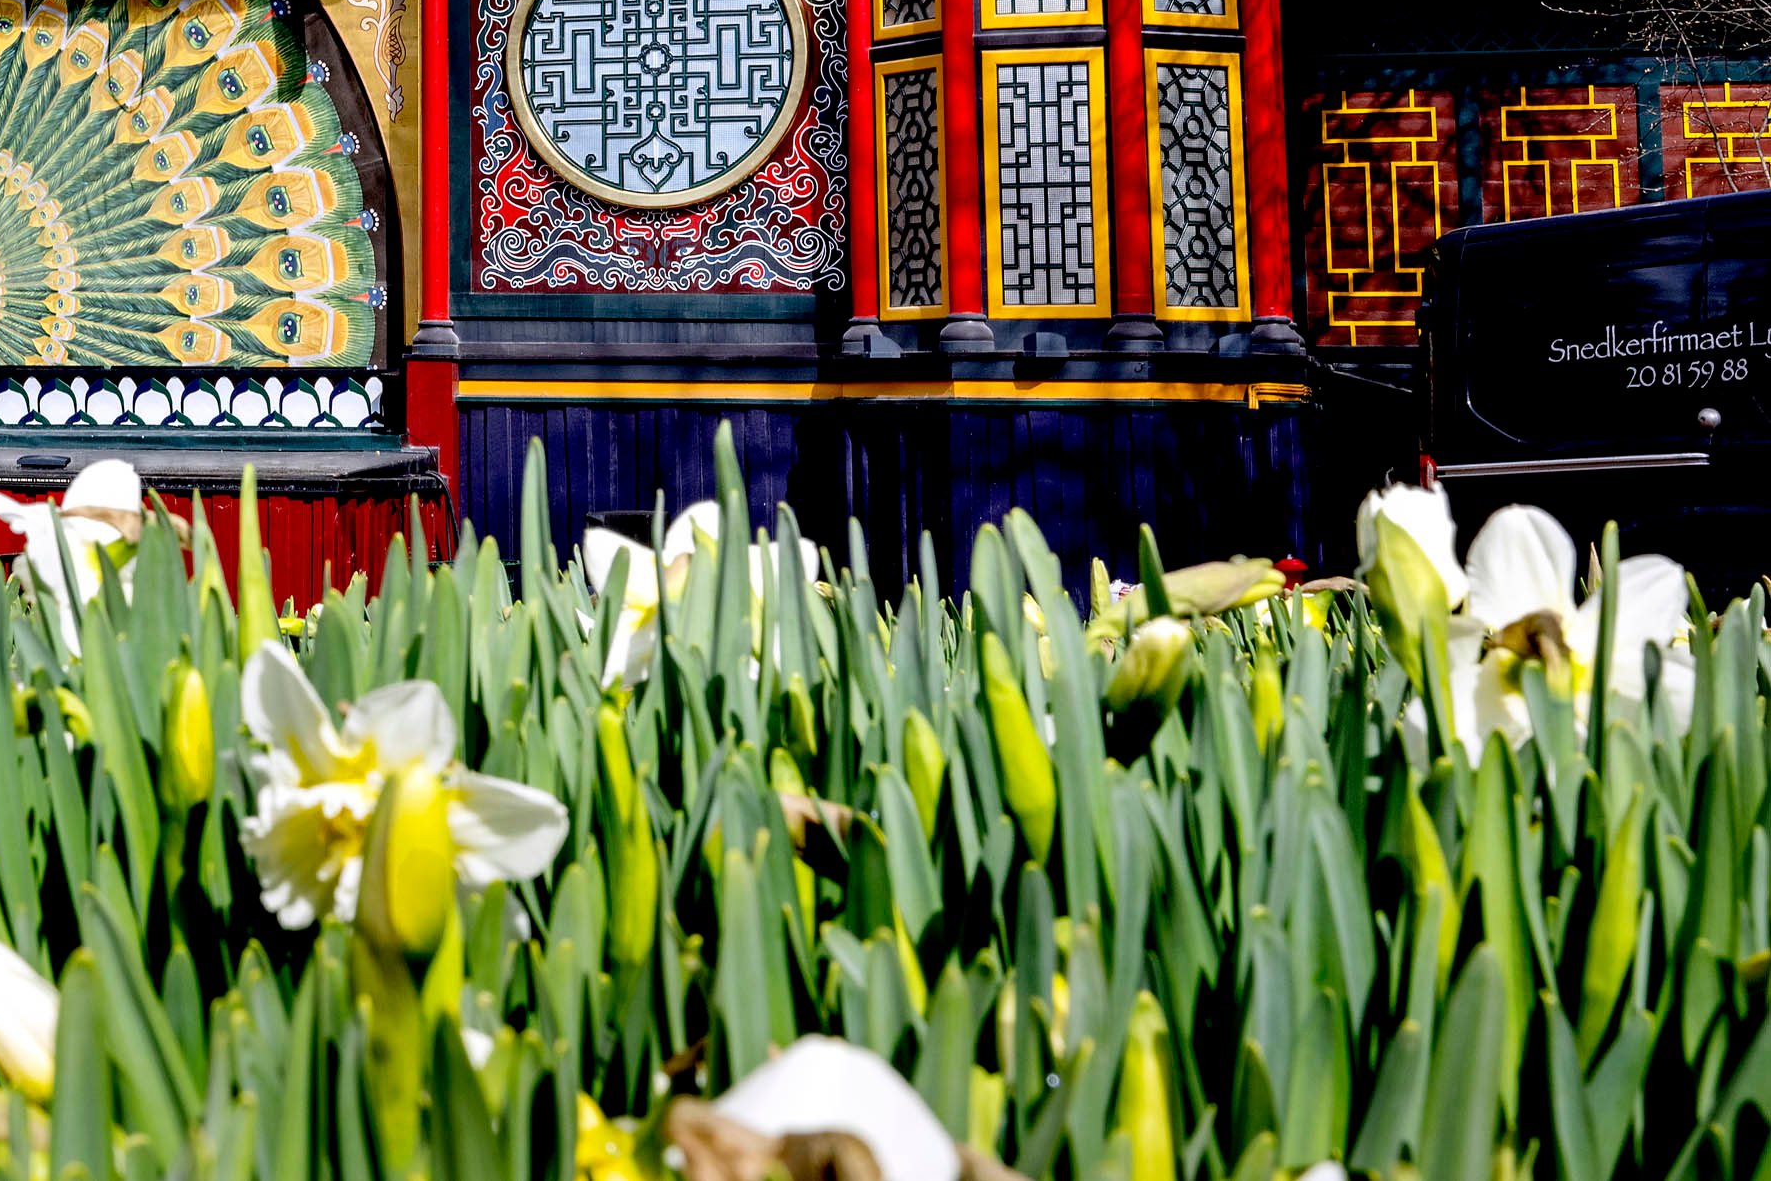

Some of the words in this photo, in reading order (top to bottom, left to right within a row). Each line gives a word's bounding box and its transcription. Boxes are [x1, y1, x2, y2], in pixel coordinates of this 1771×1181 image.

[1548, 321, 1743, 362] Snedkerfirmaet
[1626, 366, 1656, 389] 20
[1662, 362, 1682, 386] 81
[1688, 360, 1715, 388] 59
[1721, 358, 1749, 382] 88
